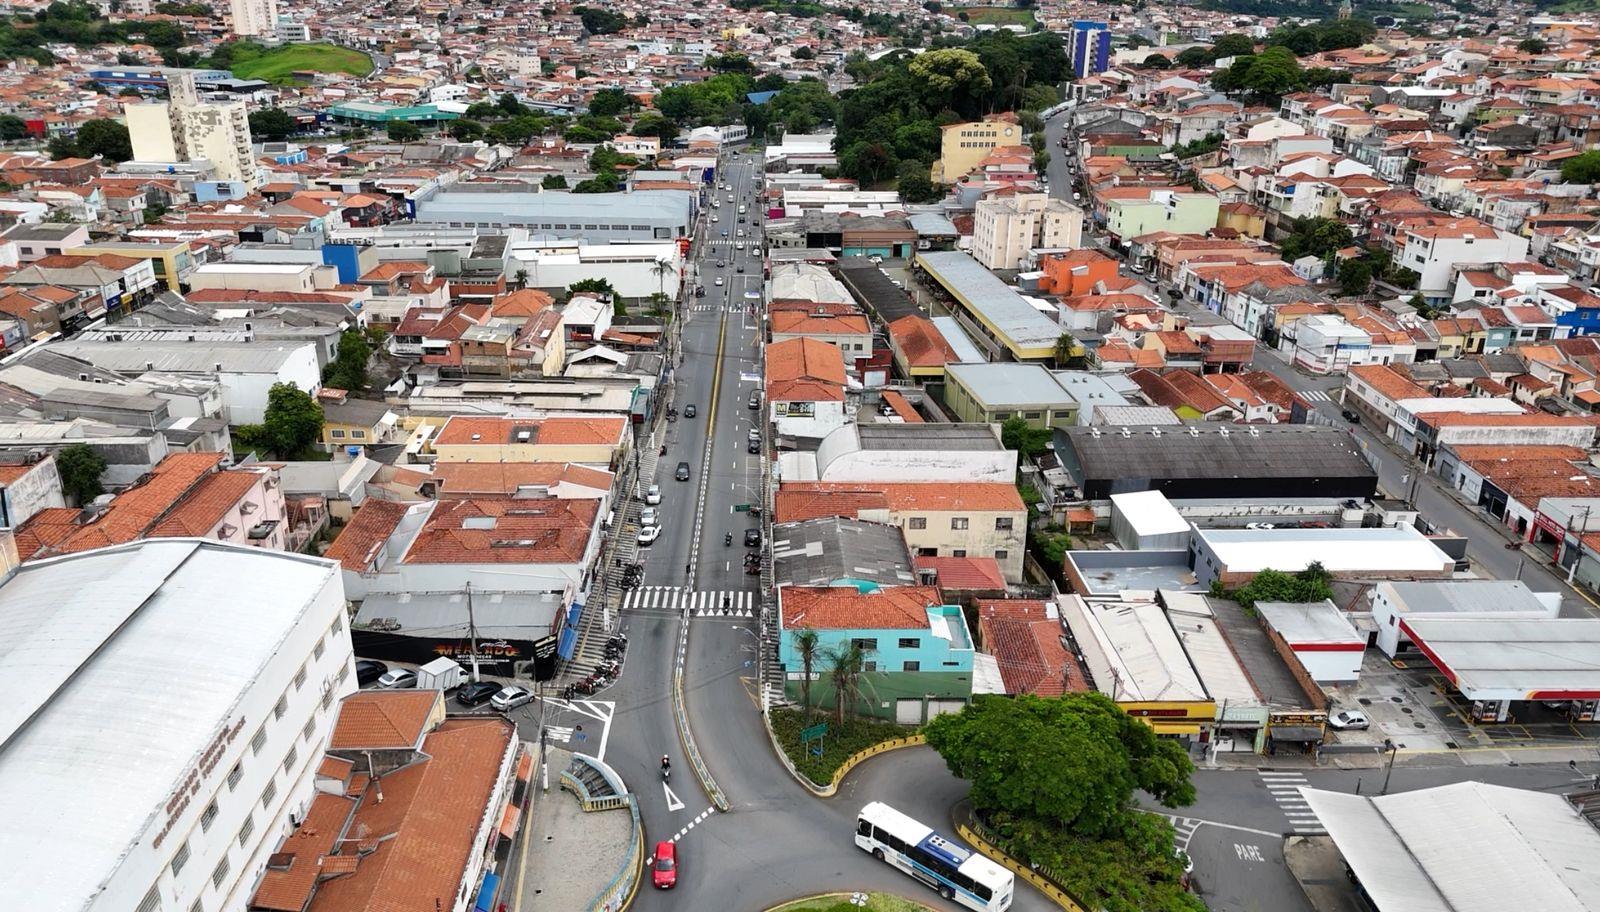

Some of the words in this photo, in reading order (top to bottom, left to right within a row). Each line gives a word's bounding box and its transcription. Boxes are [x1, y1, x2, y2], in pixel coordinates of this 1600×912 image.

[438, 645, 514, 656] MERCADO
[166, 767, 199, 814] MERCADO
[191, 778, 201, 796] DE
[1234, 843, 1264, 861] PARE
